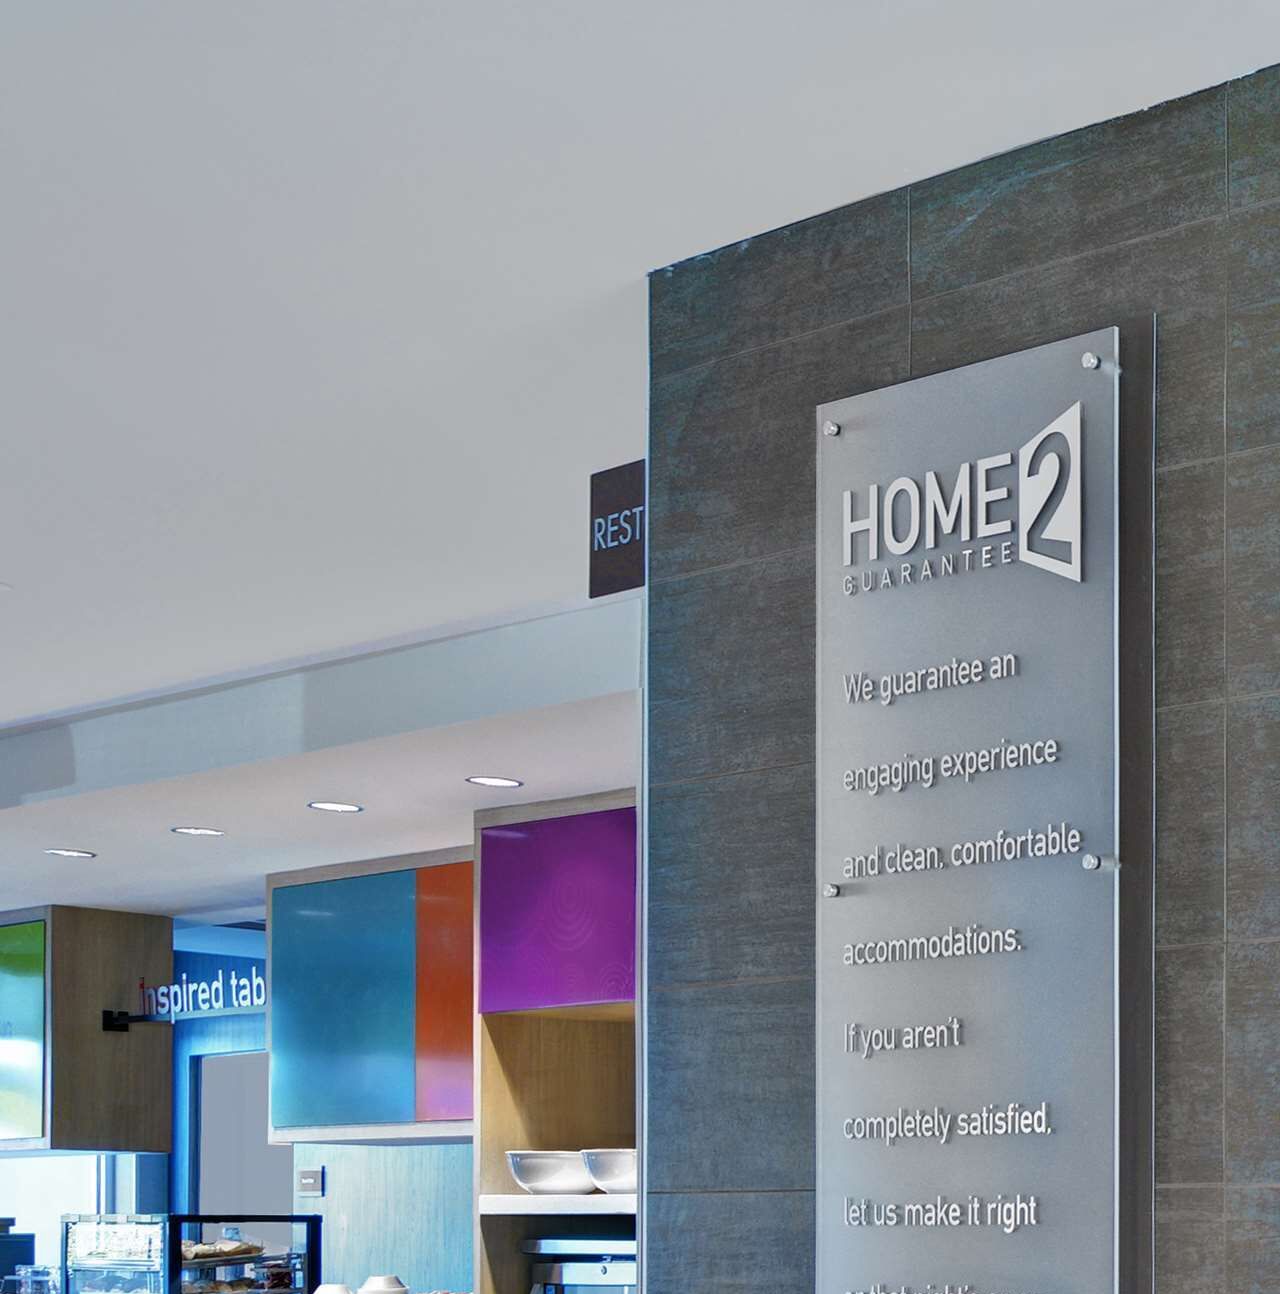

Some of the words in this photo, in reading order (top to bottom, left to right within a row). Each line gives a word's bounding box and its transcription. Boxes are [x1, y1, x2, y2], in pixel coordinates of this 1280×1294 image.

[593, 505, 645, 552] REST
[843, 541, 1012, 597] GUARANTEE
[843, 672, 874, 704] We
[880, 657, 983, 706] guarantee
[989, 653, 1017, 679] an
[843, 752, 934, 797] engaging
[940, 737, 1059, 783] experience
[843, 844, 879, 879] and
[885, 840, 945, 872] clean,
[951, 822, 1081, 865] comfortable
[843, 924, 1022, 966] accommodations.
[139, 968, 224, 1025] inspired
[230, 965, 266, 1009] tab
[843, 1021, 857, 1053] If
[861, 1027, 896, 1059] you
[902, 1016, 961, 1050] aren't
[843, 1105, 951, 1146] completely
[956, 1101, 1053, 1138] satisfied,
[843, 1196, 869, 1227] let
[873, 1201, 898, 1227] us
[904, 1195, 961, 1227] make
[967, 1195, 981, 1226] it
[987, 1194, 1037, 1234] right
